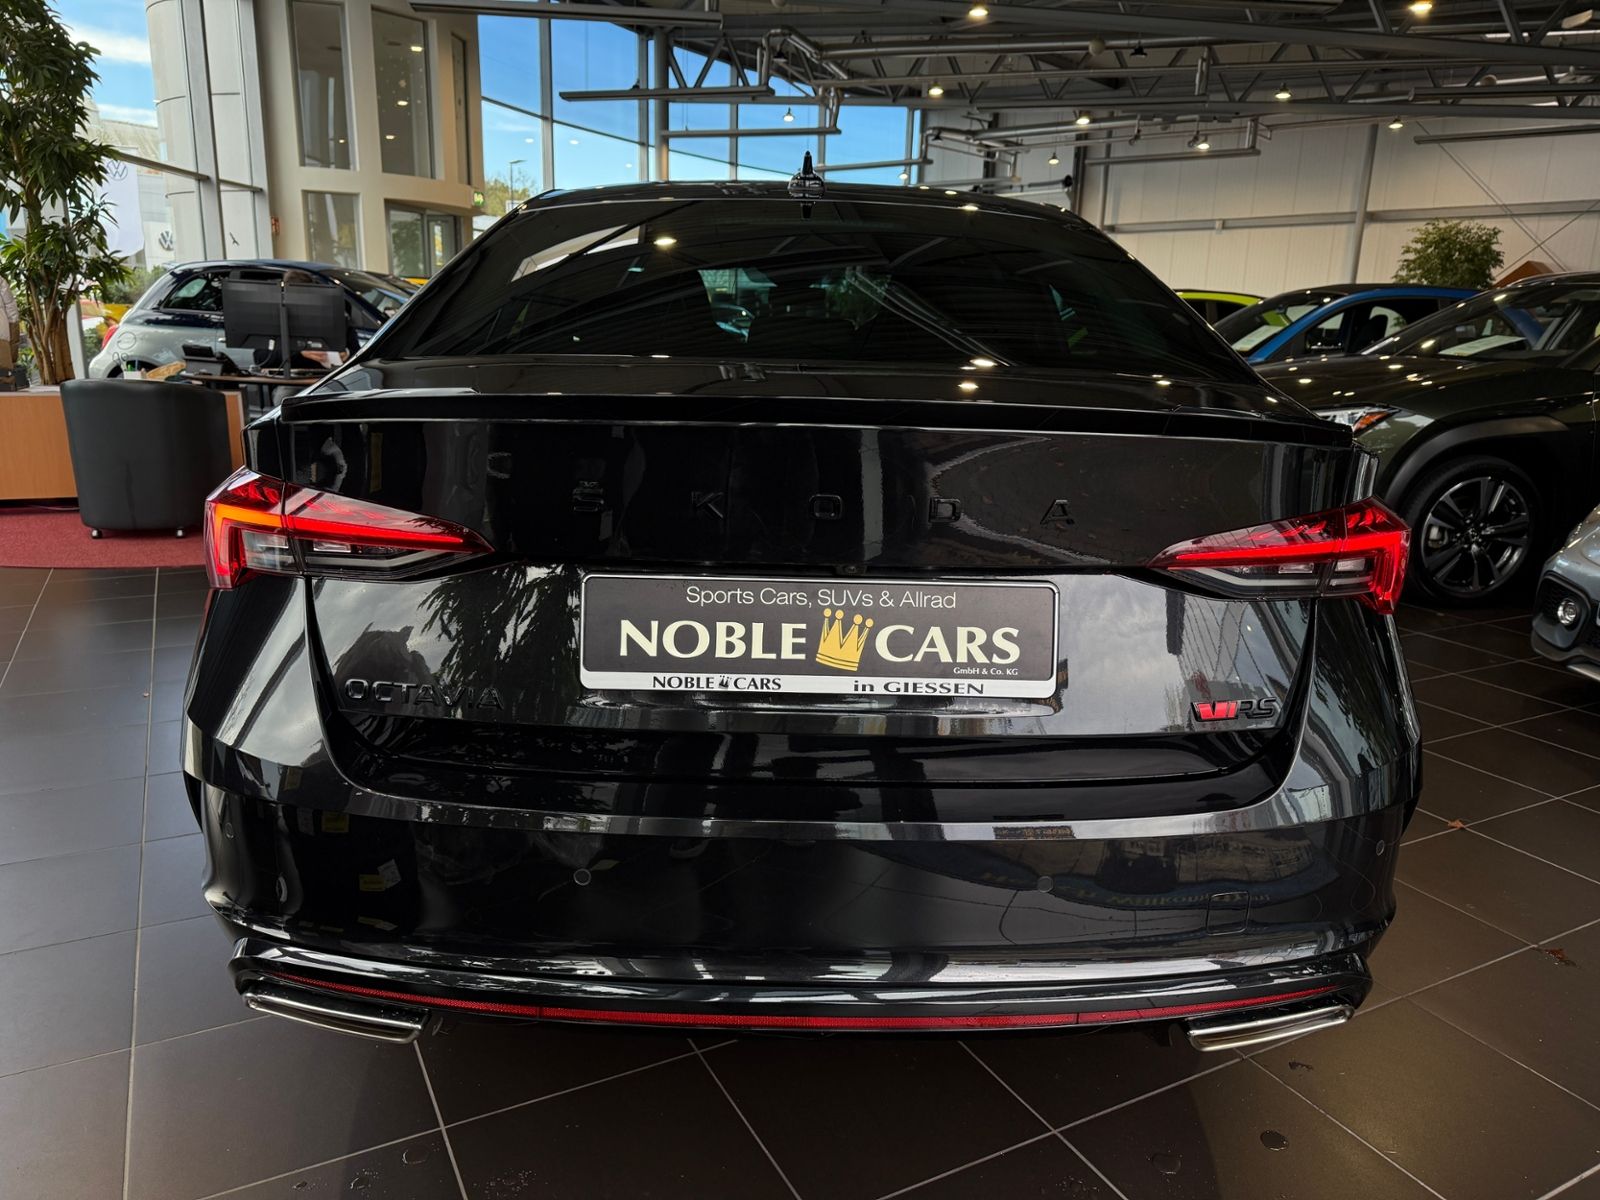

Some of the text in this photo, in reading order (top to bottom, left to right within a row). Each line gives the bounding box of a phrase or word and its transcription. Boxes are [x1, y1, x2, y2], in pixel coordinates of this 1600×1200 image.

[686, 586, 957, 609] Sports Cars, SUVs & Allrad
[619, 619, 1021, 665] NOBLE CARS
[953, 667, 1019, 676] GmbH & Co. KG
[344, 678, 504, 710] OCTAVIA
[652, 676, 984, 695] NOBLE CARS in GIESSEN
